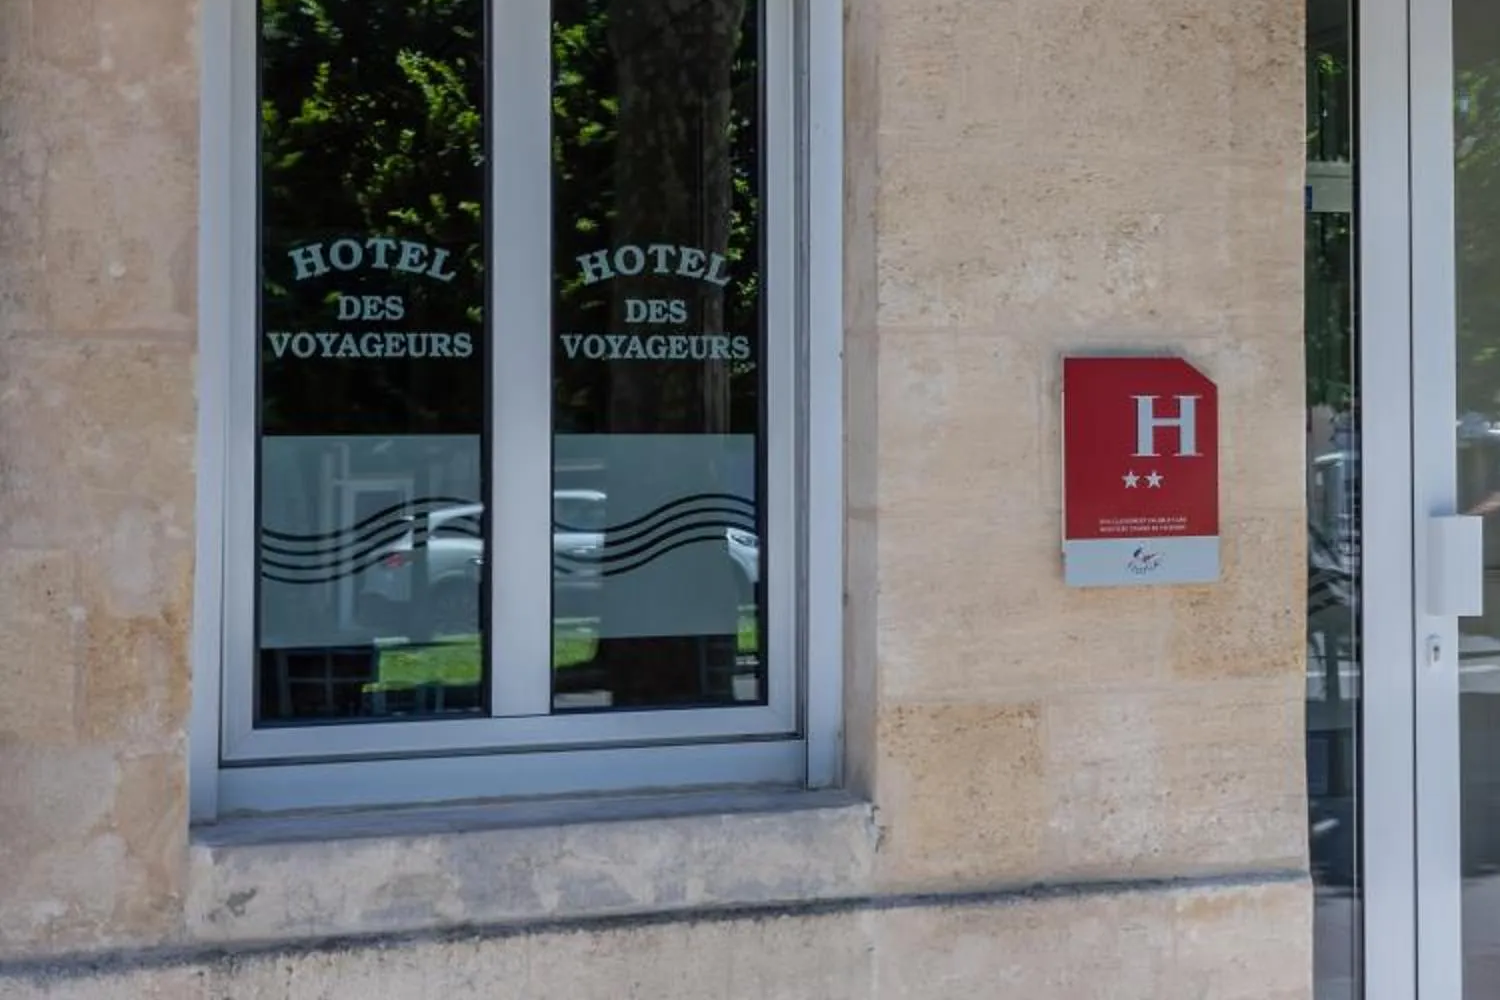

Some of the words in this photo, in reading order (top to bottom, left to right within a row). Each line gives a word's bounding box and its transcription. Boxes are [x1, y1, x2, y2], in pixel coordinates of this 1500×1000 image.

[288, 238, 457, 282] HOTEL
[576, 244, 732, 287] HOTEL
[337, 295, 405, 321] DES
[625, 299, 687, 324] DES
[266, 332, 473, 358] VOYAGEURS
[560, 334, 750, 360] VOYAGEURS
[1130, 395, 1203, 457] H
